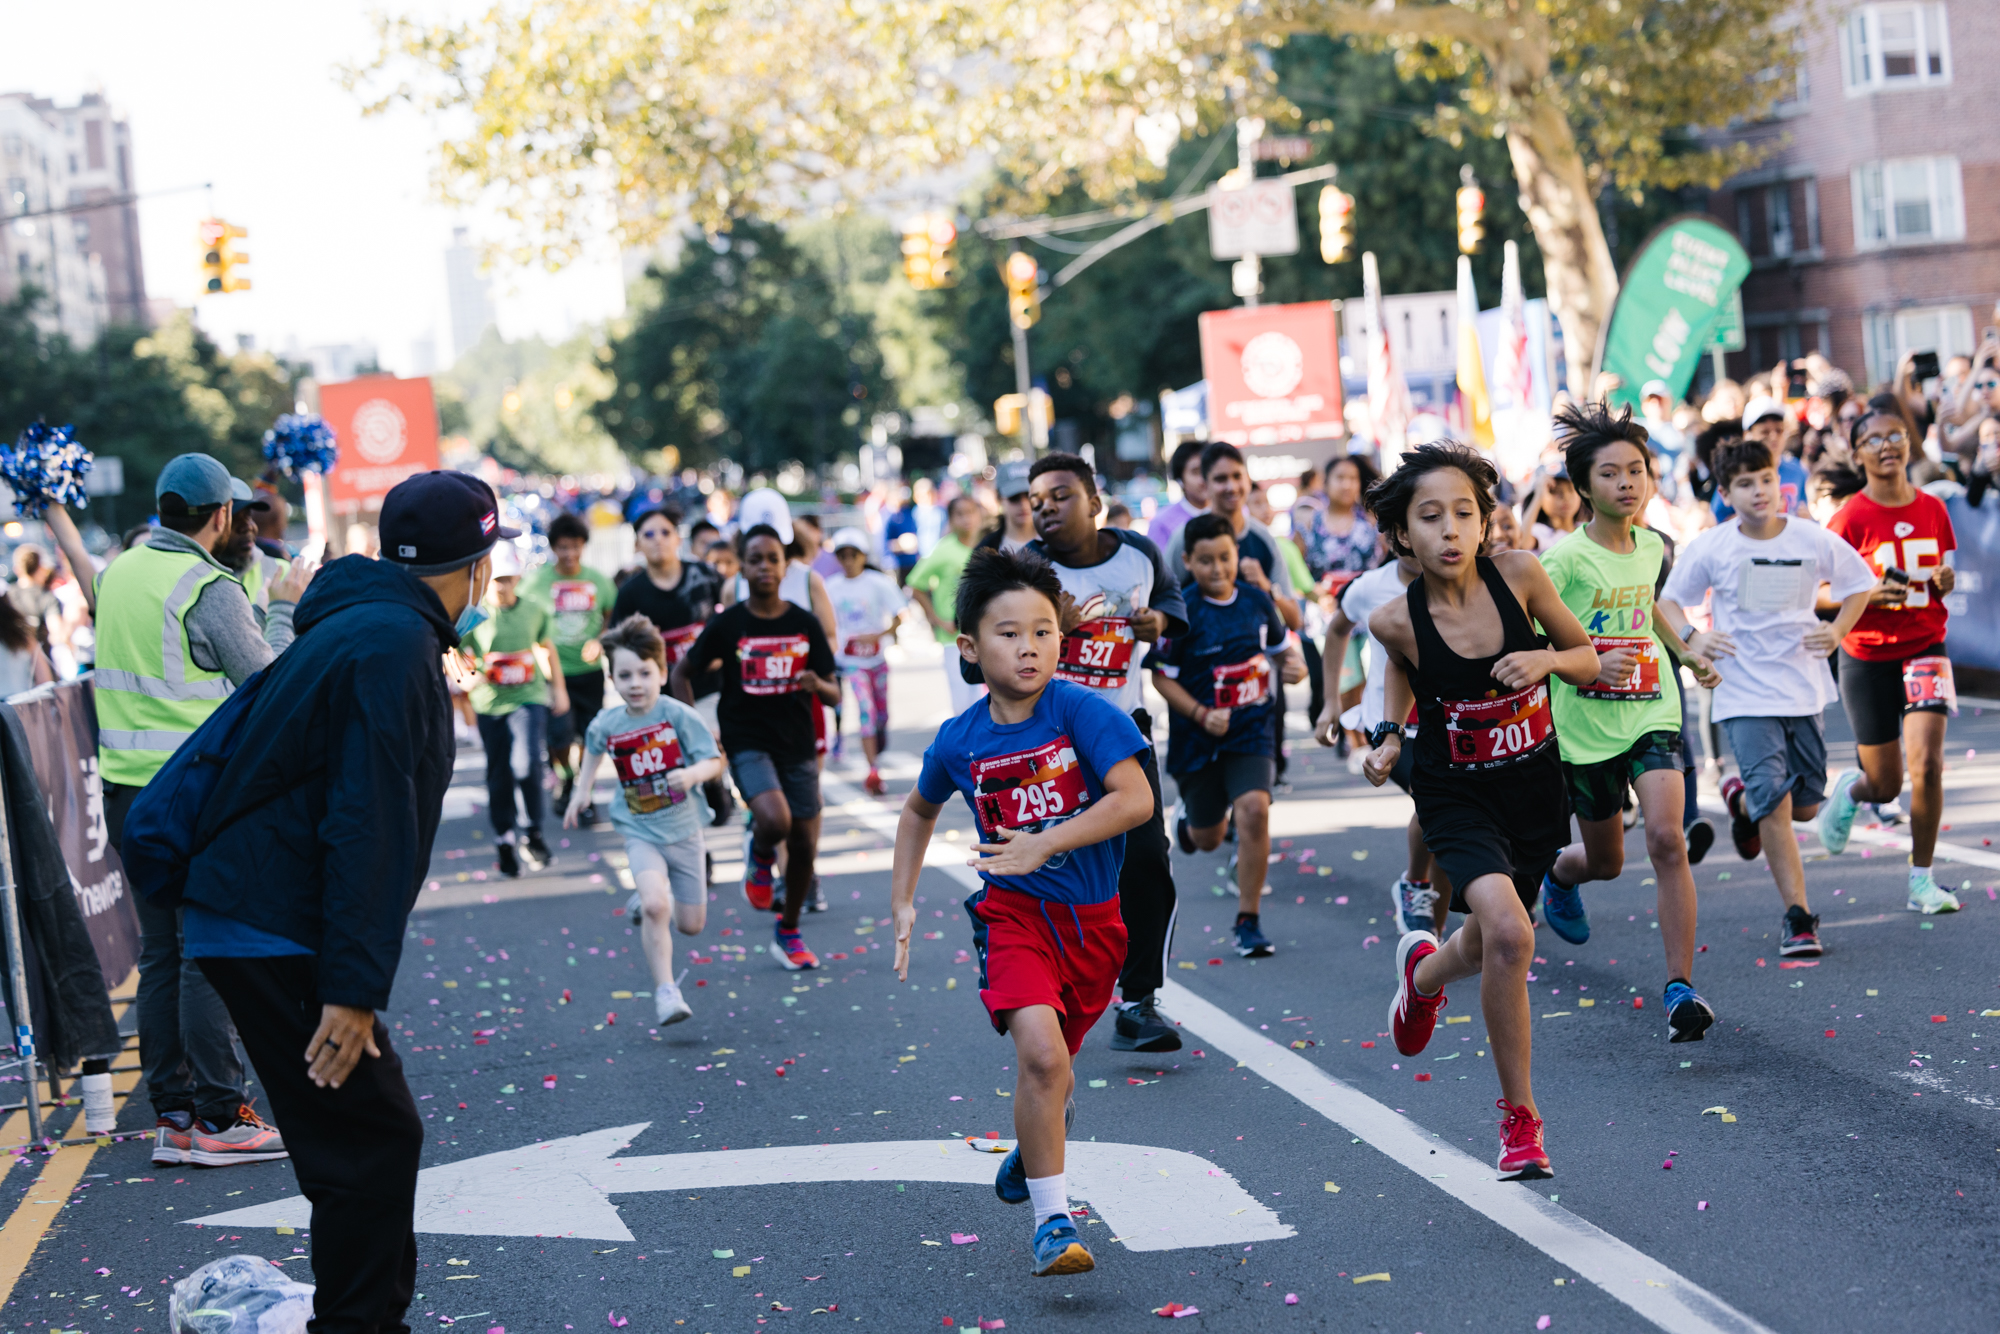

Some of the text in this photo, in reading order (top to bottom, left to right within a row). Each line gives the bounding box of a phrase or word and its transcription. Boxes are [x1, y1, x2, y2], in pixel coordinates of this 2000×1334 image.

[1645, 306, 1690, 379] LOW
[1873, 538, 1940, 609] 15
[1588, 608, 1651, 634] KID
[765, 656, 793, 679] 517
[1078, 639, 1115, 667] 527
[1236, 677, 1260, 705] 220
[1909, 681, 1922, 697] D
[1456, 718, 1535, 757] G 201
[630, 747, 667, 777] 642
[983, 779, 1064, 825] H 295
